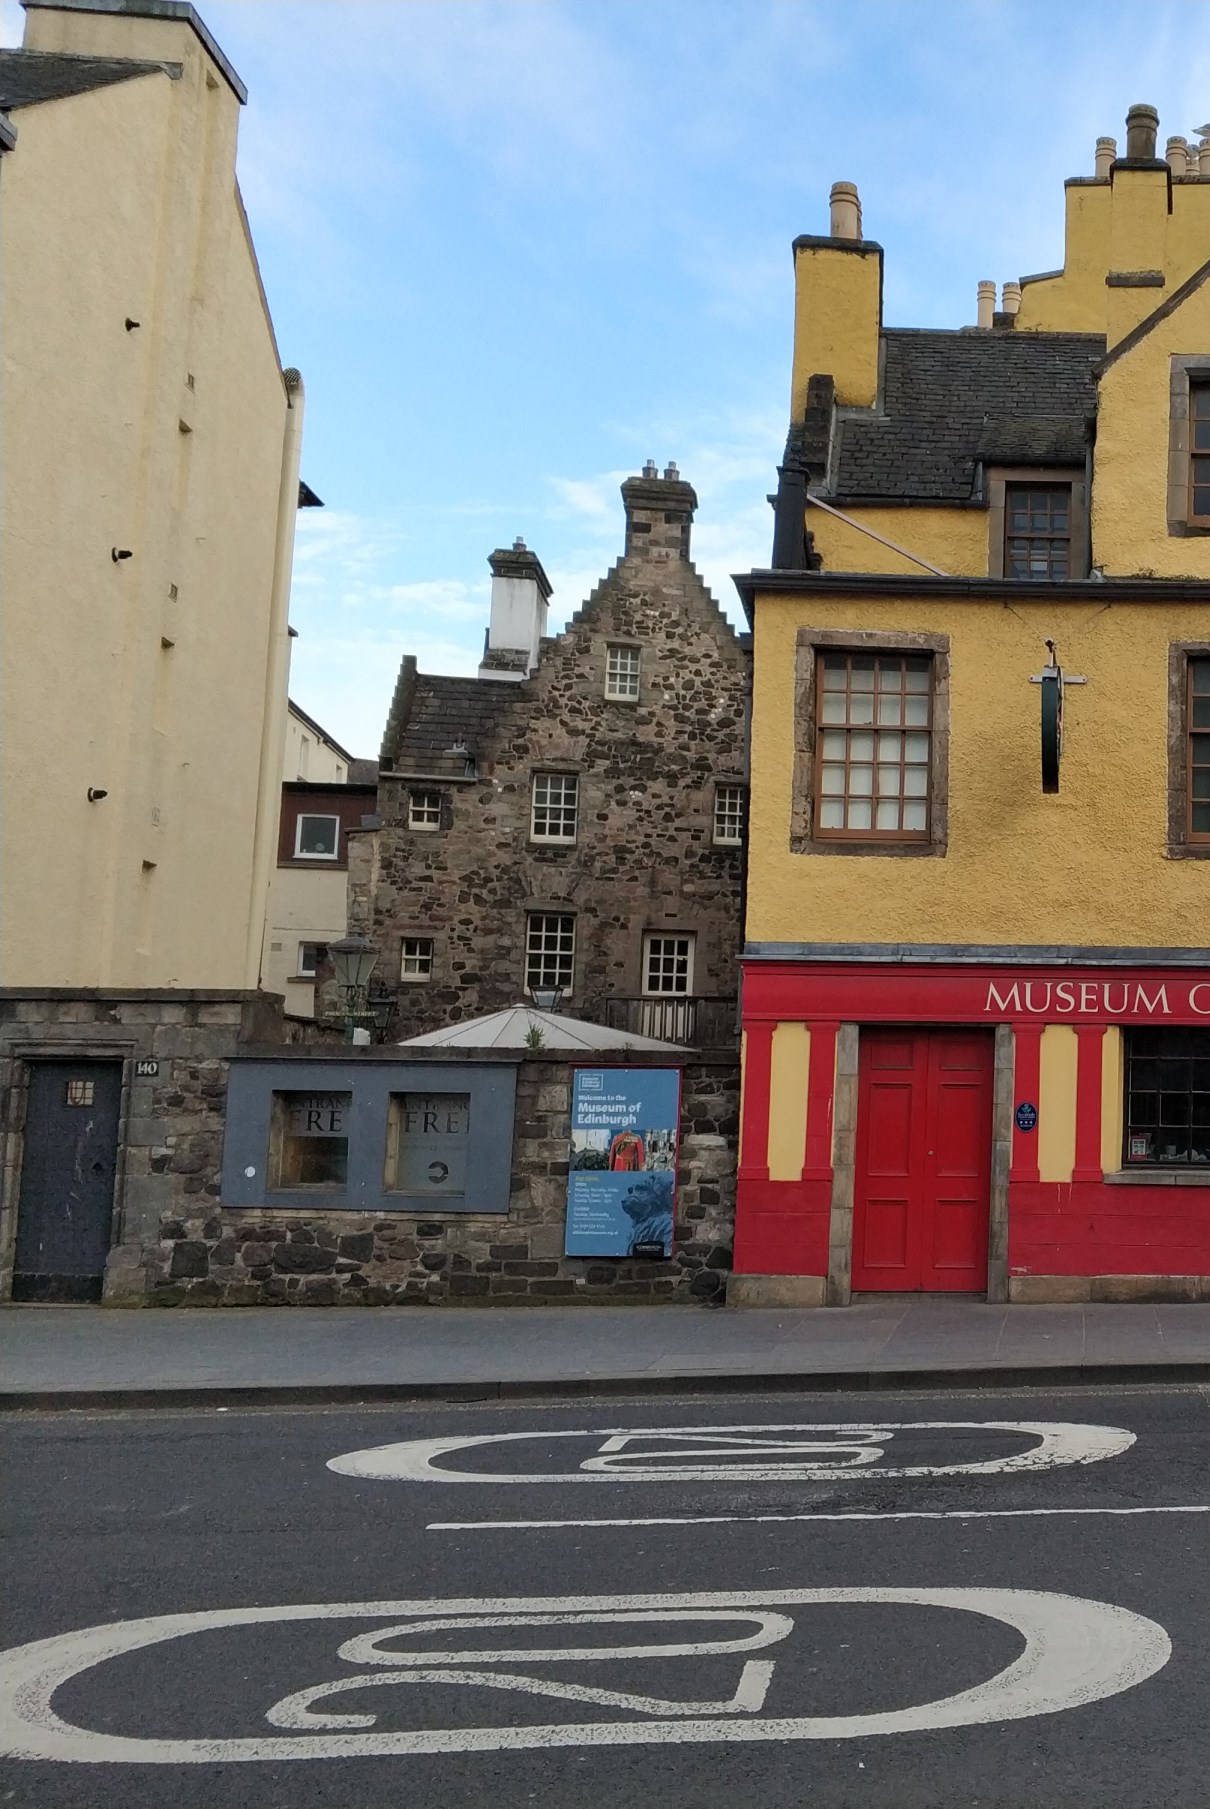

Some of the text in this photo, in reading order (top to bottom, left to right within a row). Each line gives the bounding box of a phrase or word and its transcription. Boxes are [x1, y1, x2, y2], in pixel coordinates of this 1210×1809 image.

[984, 981, 1172, 1014] MUSEUM
[137, 1062, 158, 1074] 140
[578, 1102, 642, 1113] Museum of
[404, 1111, 469, 1134] FRE
[577, 1113, 637, 1127] Edinburgh
[266, 1610, 795, 1730] 20
